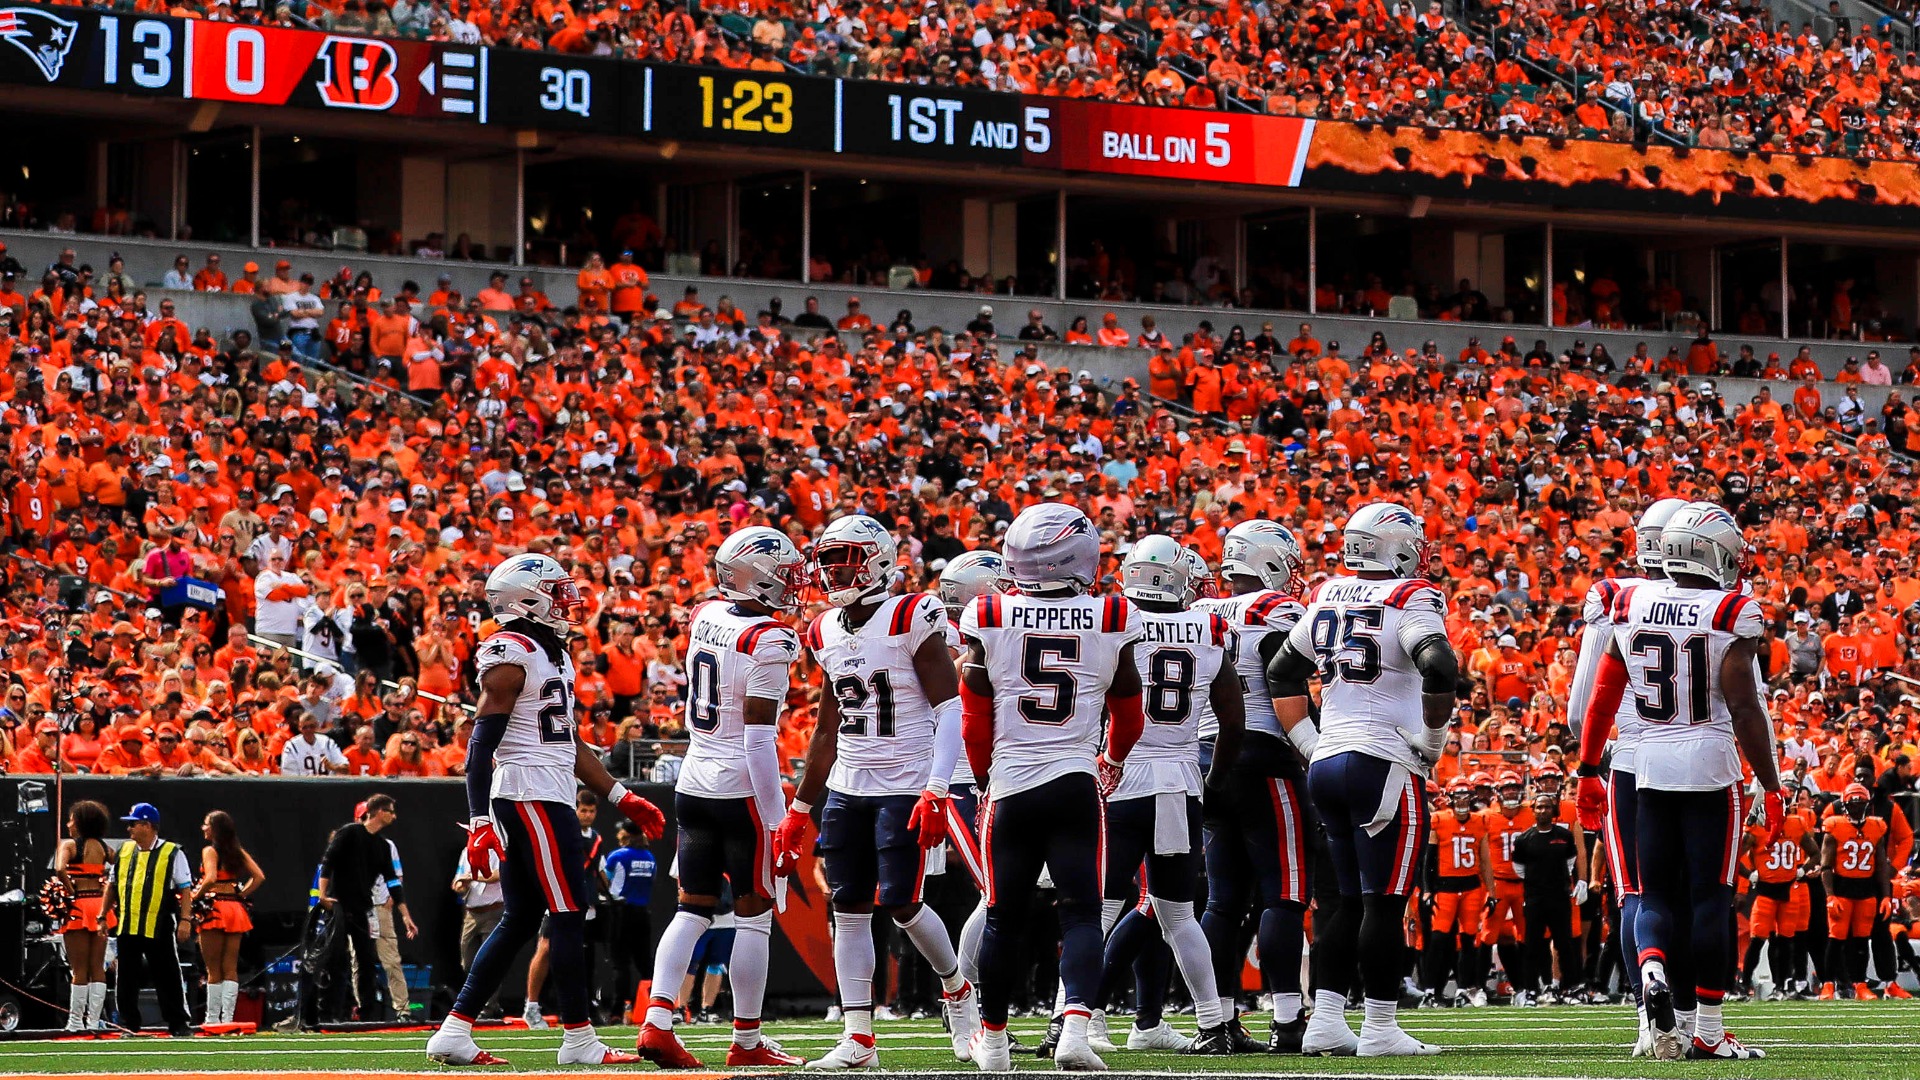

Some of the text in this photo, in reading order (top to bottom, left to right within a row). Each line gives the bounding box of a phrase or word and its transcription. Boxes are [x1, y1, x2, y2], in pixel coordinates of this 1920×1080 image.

[101, 16, 173, 88] 13
[226, 28, 265, 95] 0
[540, 66, 590, 117] 3Q
[699, 76, 793, 134] 1:23
[888, 94, 1051, 153] 1ST AND 5
[1103, 122, 1231, 167] BALL ON 5
[30, 497, 43, 521] 9
[1136, 590, 1163, 601] PATRIOTS
[1152, 575, 1160, 587] 8
[468, 611, 482, 634] 9
[1011, 606, 1094, 631] PEPPERS
[1642, 602, 1701, 627] JONES
[1311, 606, 1385, 689] 95
[690, 648, 721, 735] 0
[835, 668, 896, 738] 21
[1017, 633, 1083, 727] 5
[1145, 647, 1197, 725] 8
[1629, 630, 1712, 725] 31
[537, 676, 576, 746] 2
[1451, 836, 1476, 870] 15
[1765, 840, 1796, 871] 30
[1842, 840, 1874, 871] 32
